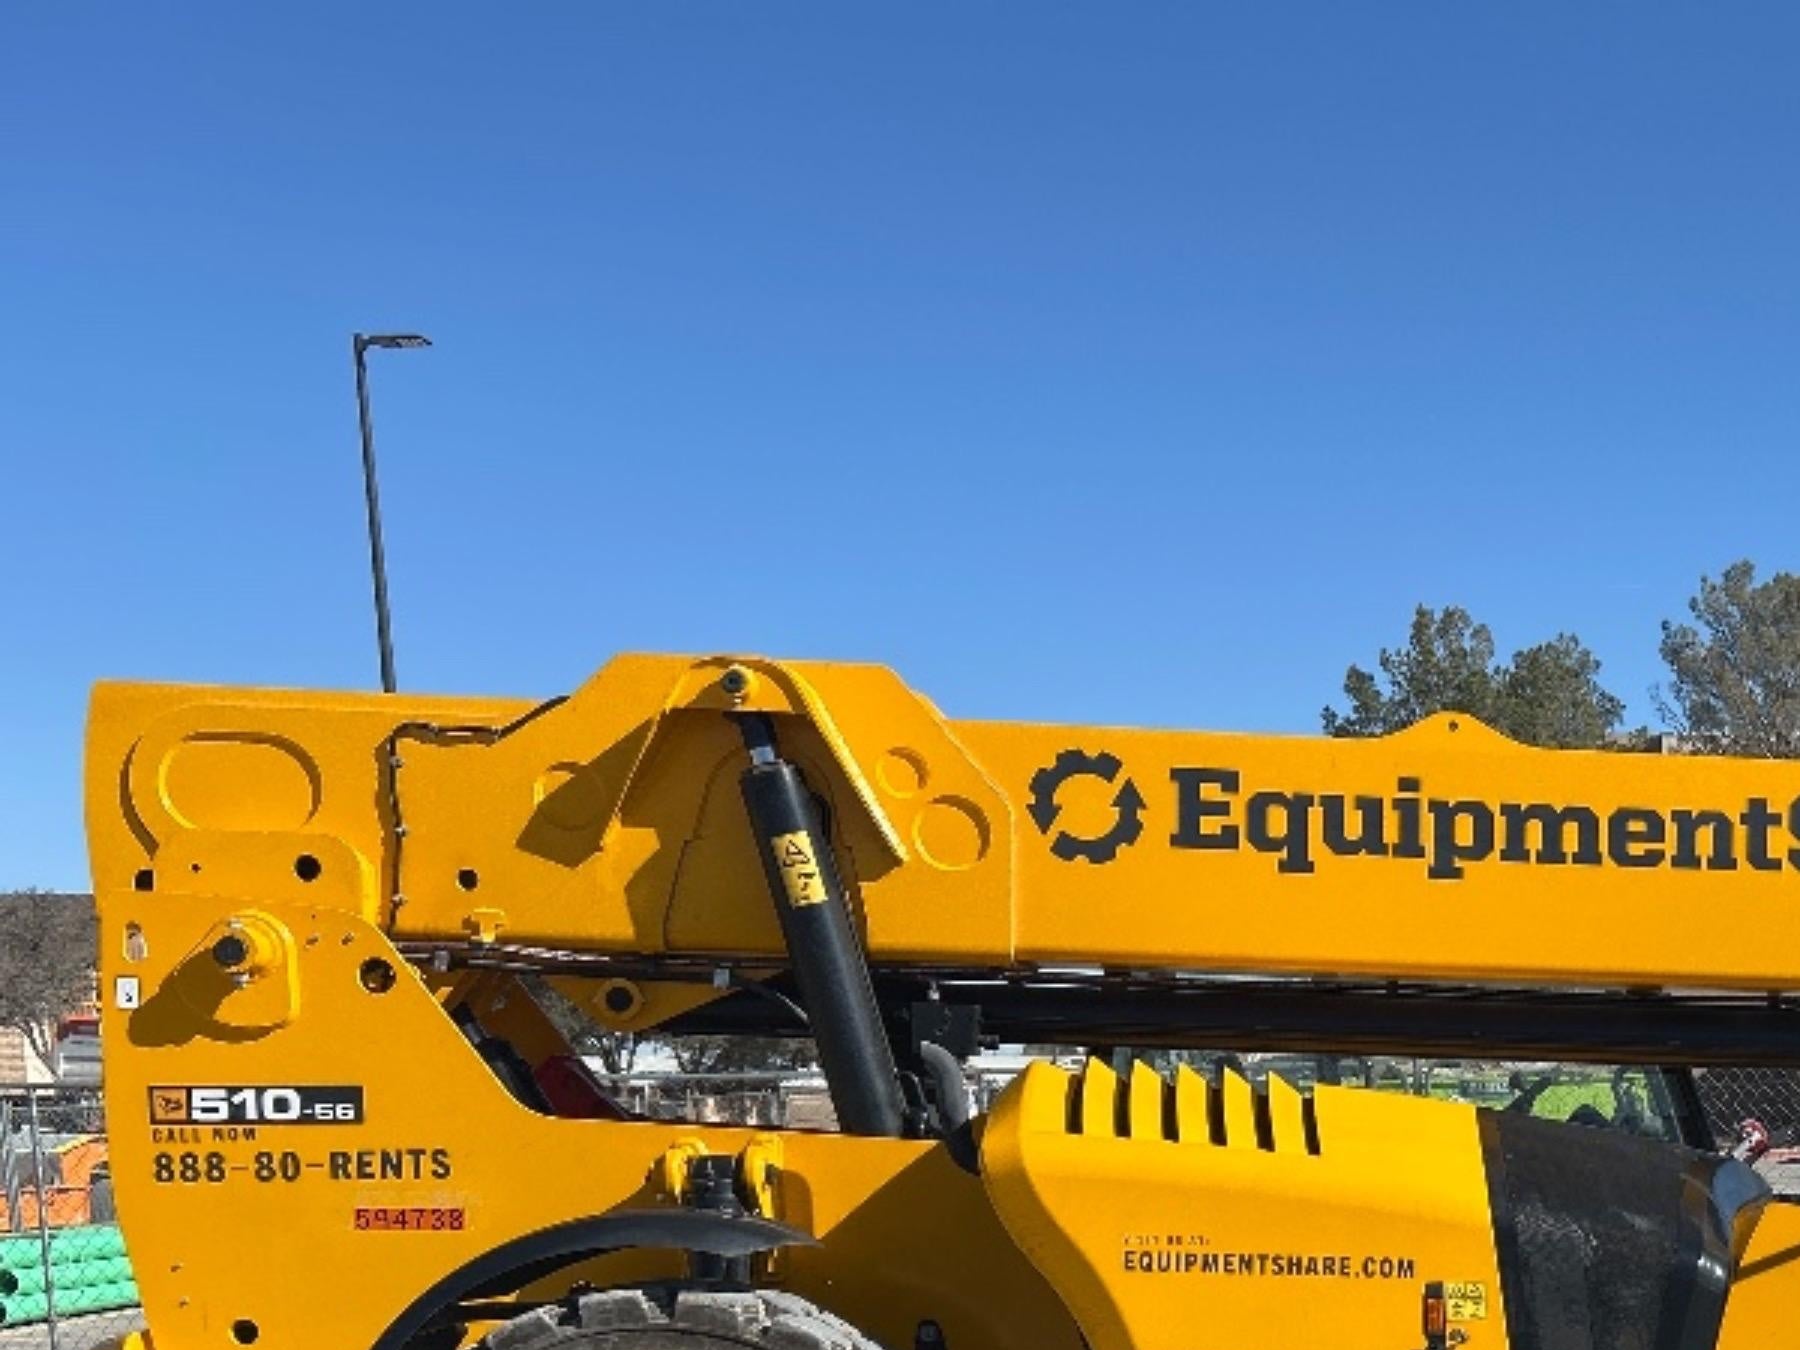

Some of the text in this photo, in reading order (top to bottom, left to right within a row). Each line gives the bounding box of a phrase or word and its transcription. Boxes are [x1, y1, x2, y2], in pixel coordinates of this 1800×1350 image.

[190, 1088, 355, 1121] 510-56
[152, 1127, 257, 1144] CALL NOW
[153, 1149, 451, 1183] 888-80-RENTS
[354, 1208, 464, 1231] 594738
[1123, 1251, 1415, 1279] EQUIPMENTSHARE.COM
